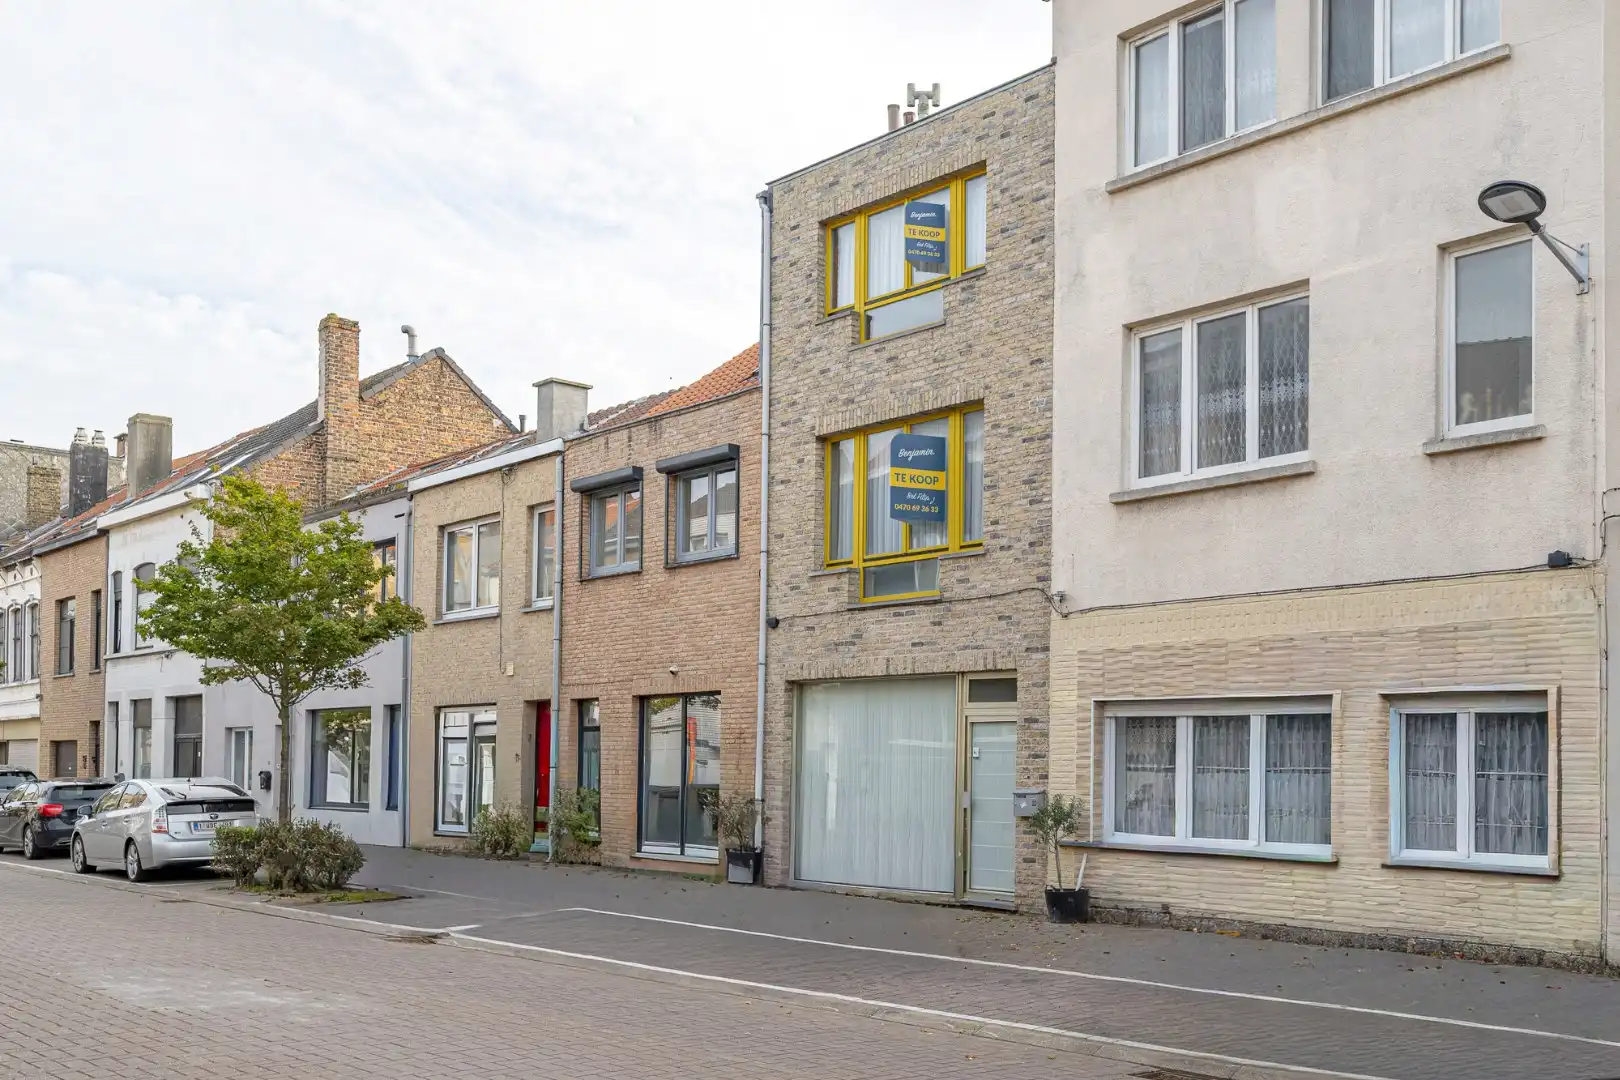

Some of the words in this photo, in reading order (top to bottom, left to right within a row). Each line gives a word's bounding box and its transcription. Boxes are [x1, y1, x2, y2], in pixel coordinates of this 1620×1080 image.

[908, 228, 916, 236] TE
[919, 230, 940, 238] KOOP
[894, 472, 906, 482] TE
[910, 474, 939, 485] KOOP
[911, 504, 920, 512] 69
